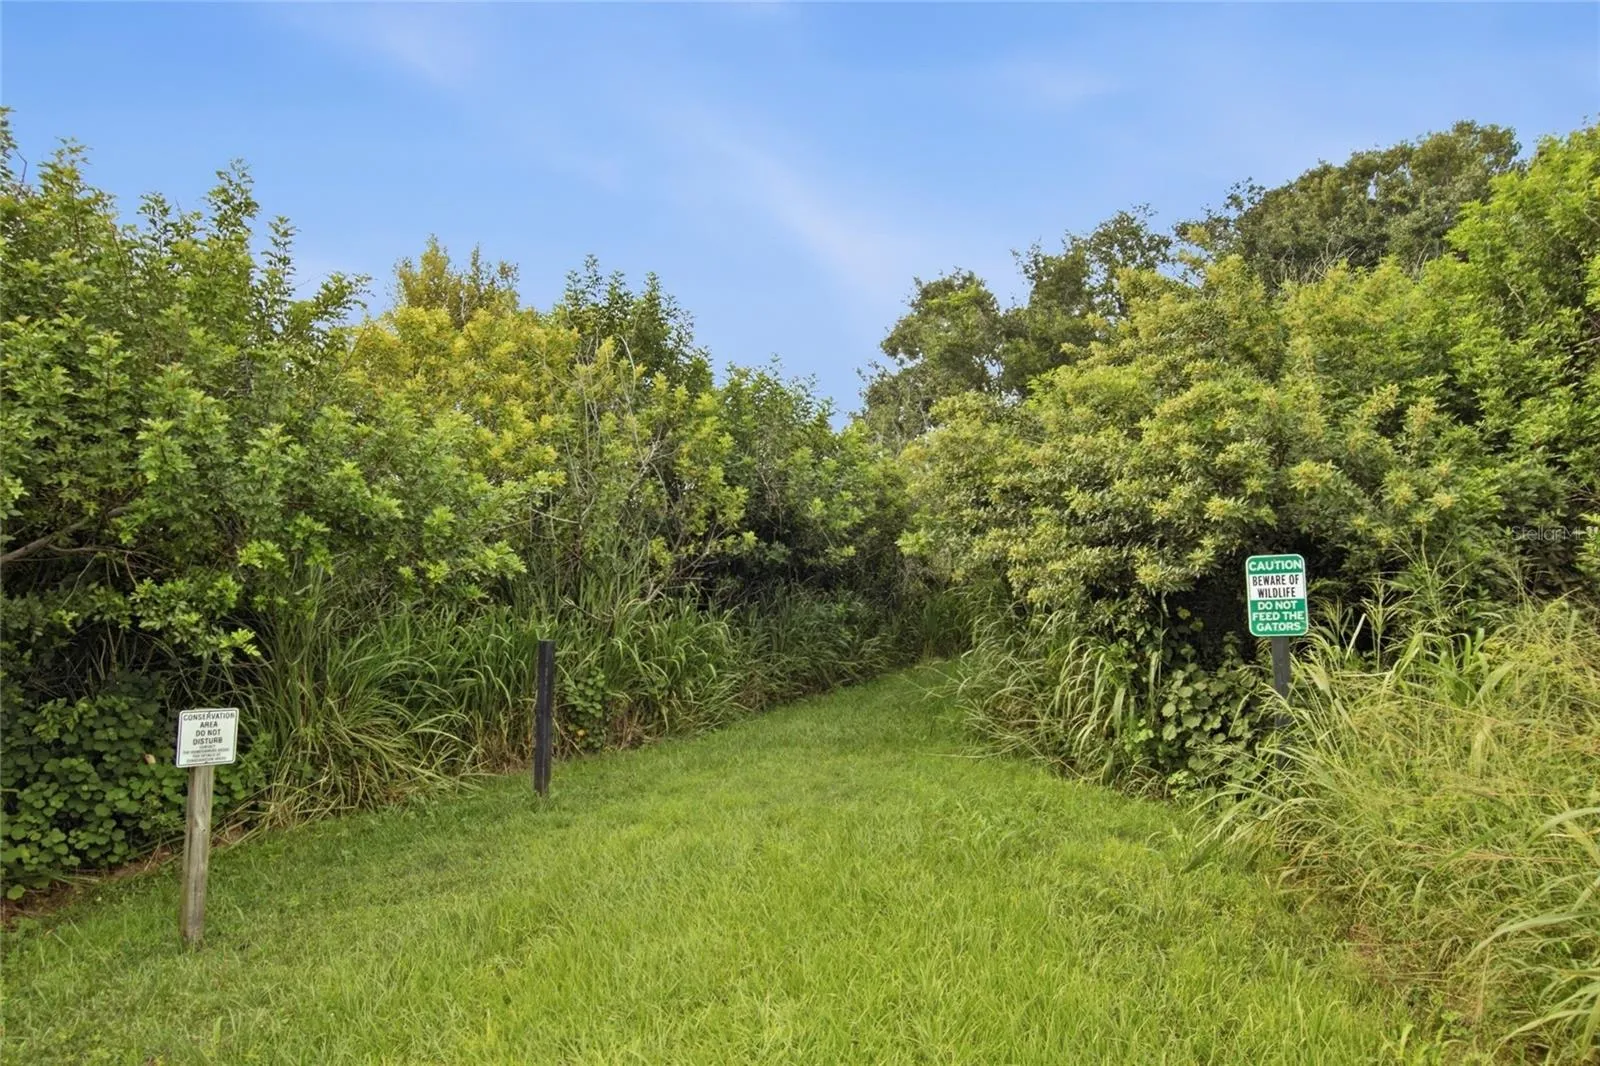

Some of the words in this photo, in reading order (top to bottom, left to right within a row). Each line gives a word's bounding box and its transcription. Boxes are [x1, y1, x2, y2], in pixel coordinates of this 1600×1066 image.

[1249, 560, 1302, 571] CAUTION
[1252, 574, 1287, 586] BEWARE
[1289, 574, 1299, 585] OF
[1257, 587, 1296, 598] WILDLIFE
[1257, 601, 1273, 610] DO
[1275, 600, 1298, 610] NOT
[1252, 611, 1280, 621] FEED
[1282, 610, 1304, 620] THE
[1256, 622, 1301, 632] GATORS
[183, 712, 235, 721] CONSERVATION
[192, 736, 223, 745] DISTURB
